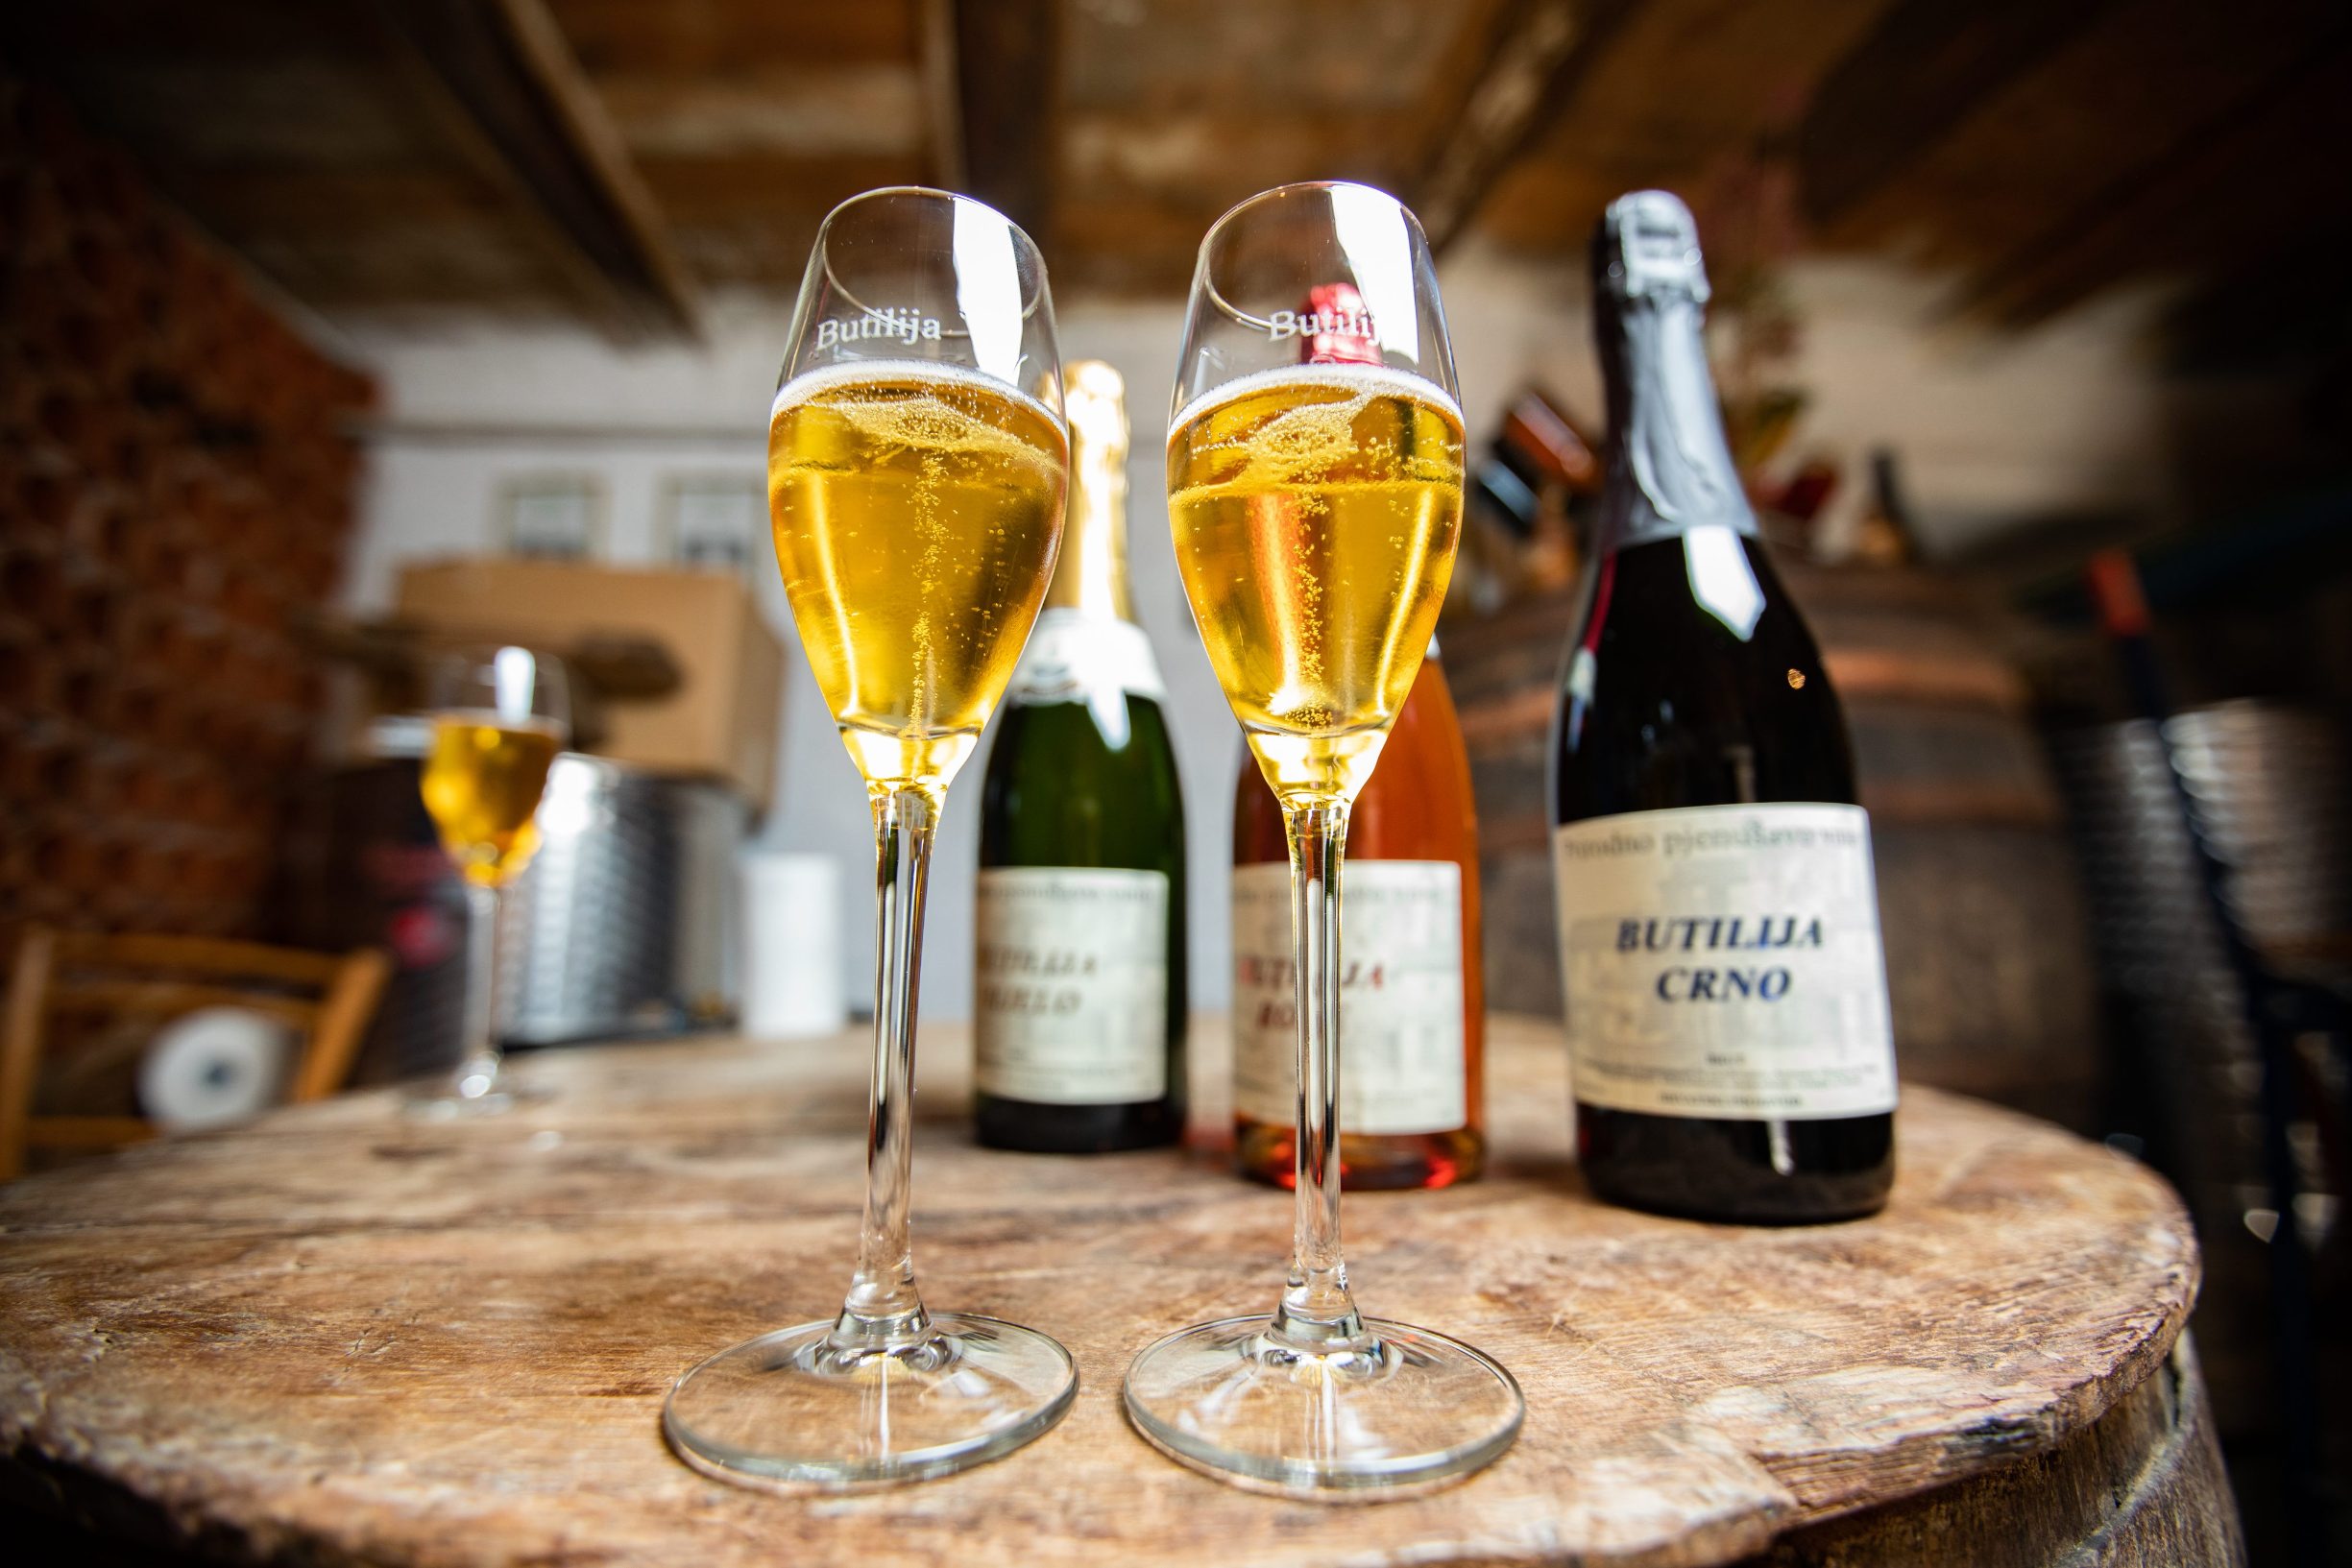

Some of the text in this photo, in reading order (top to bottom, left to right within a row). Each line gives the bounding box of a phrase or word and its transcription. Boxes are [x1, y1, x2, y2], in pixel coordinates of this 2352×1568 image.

[815, 306, 942, 350] Butilija
[1268, 307, 1381, 347] Butilij
[1615, 915, 1823, 953] BUTILIJA
[1656, 967, 1792, 1002] CRNO
